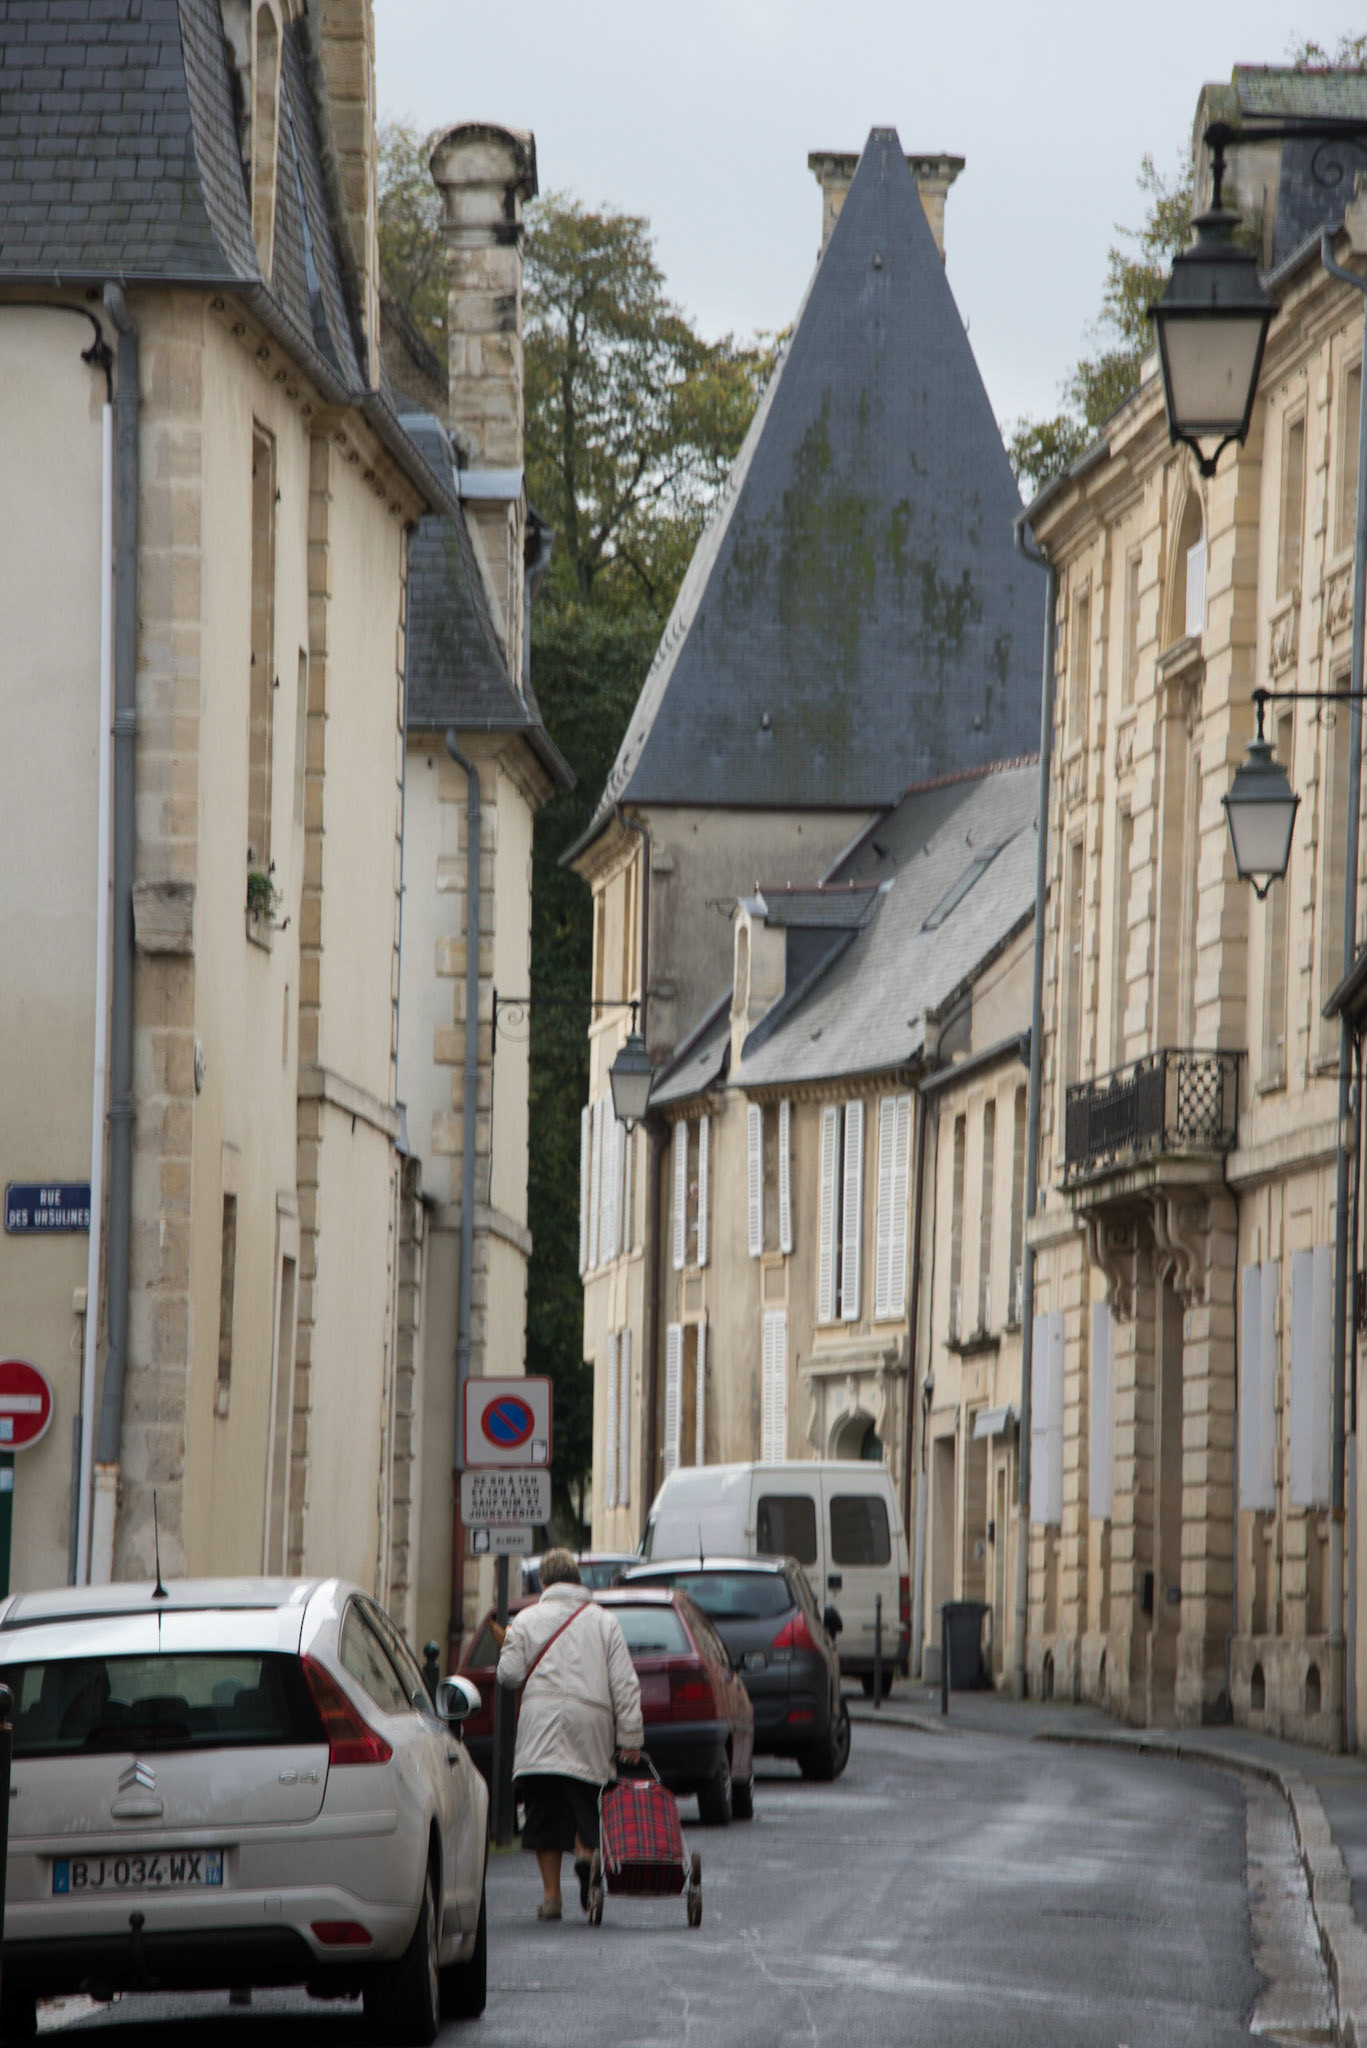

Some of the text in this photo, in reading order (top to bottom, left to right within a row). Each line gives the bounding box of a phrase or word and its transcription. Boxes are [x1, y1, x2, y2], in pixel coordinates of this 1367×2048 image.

[40, 1189, 62, 1206] RUE
[9, 1208, 90, 1227] DES URSULINES
[469, 1507, 503, 1519] JOURS
